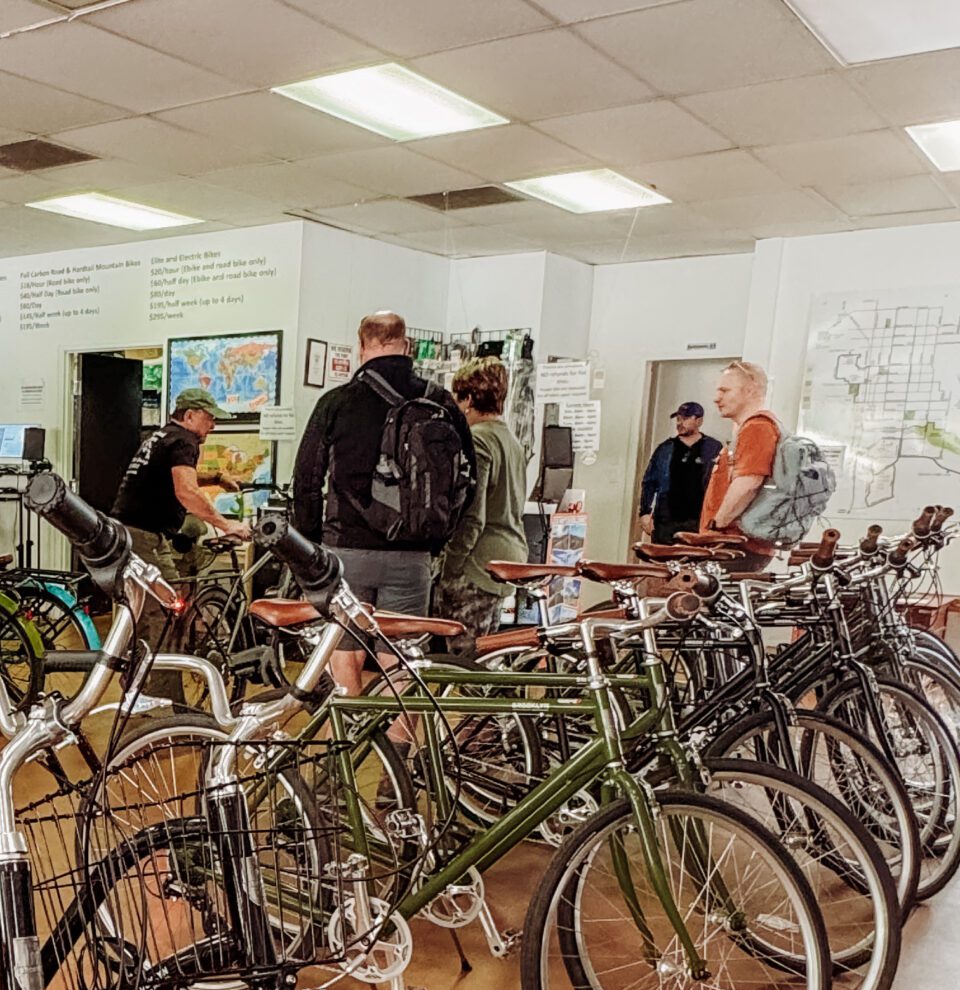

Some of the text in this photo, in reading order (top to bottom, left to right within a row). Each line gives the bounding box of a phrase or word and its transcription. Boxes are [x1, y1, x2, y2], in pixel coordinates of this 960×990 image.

[151, 257, 164, 265] Elite
[179, 253, 202, 262] Electric
[204, 250, 221, 259] Bikes
[202, 262, 214, 270] and
[216, 260, 231, 268] road
[232, 258, 247, 267] bike
[248, 256, 266, 265] only)
[20, 271, 29, 279] Full
[30, 269, 49, 277] Carbon
[72, 264, 94, 272] Hardtail
[95, 262, 124, 271] Mountain
[125, 259, 141, 267] Bikes
[76, 276, 90, 284] only)
[178, 276, 189, 285] day
[212, 273, 224, 281] and
[226, 271, 242, 280] road
[243, 269, 257, 278] bike
[259, 268, 277, 277] only)
[72, 287, 84, 295] bike
[85, 286, 100, 294] only)
[181, 299, 197, 307] week
[199, 297, 210, 307] (up
[212, 297, 219, 305] to
[226, 295, 244, 304] days)
[47, 310, 61, 318] week
[62, 310, 71, 318] (up
[84, 307, 100, 315] days)
